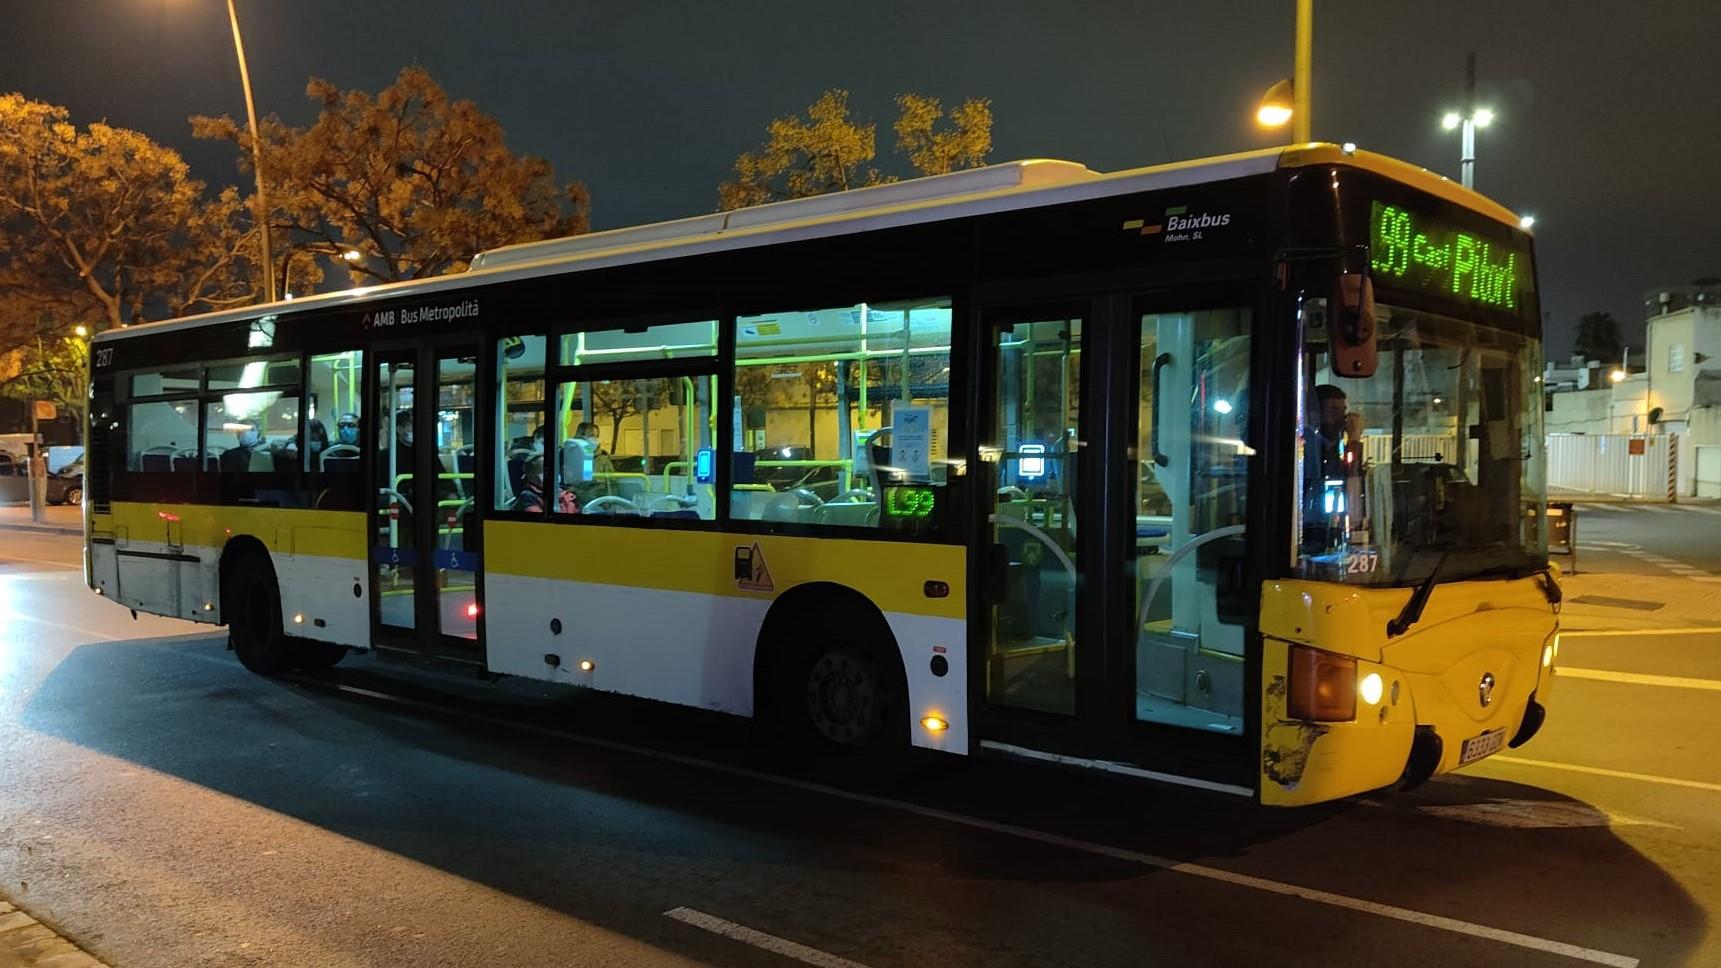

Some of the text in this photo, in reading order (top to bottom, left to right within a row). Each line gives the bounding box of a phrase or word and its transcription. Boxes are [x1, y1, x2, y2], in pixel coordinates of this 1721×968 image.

[1166, 212, 1231, 232] Baixbus
[373, 299, 479, 327] AMB Bus Metropolità
[96, 348, 113, 368] 287
[889, 489, 934, 517] L99
[1347, 552, 1378, 574] 287
